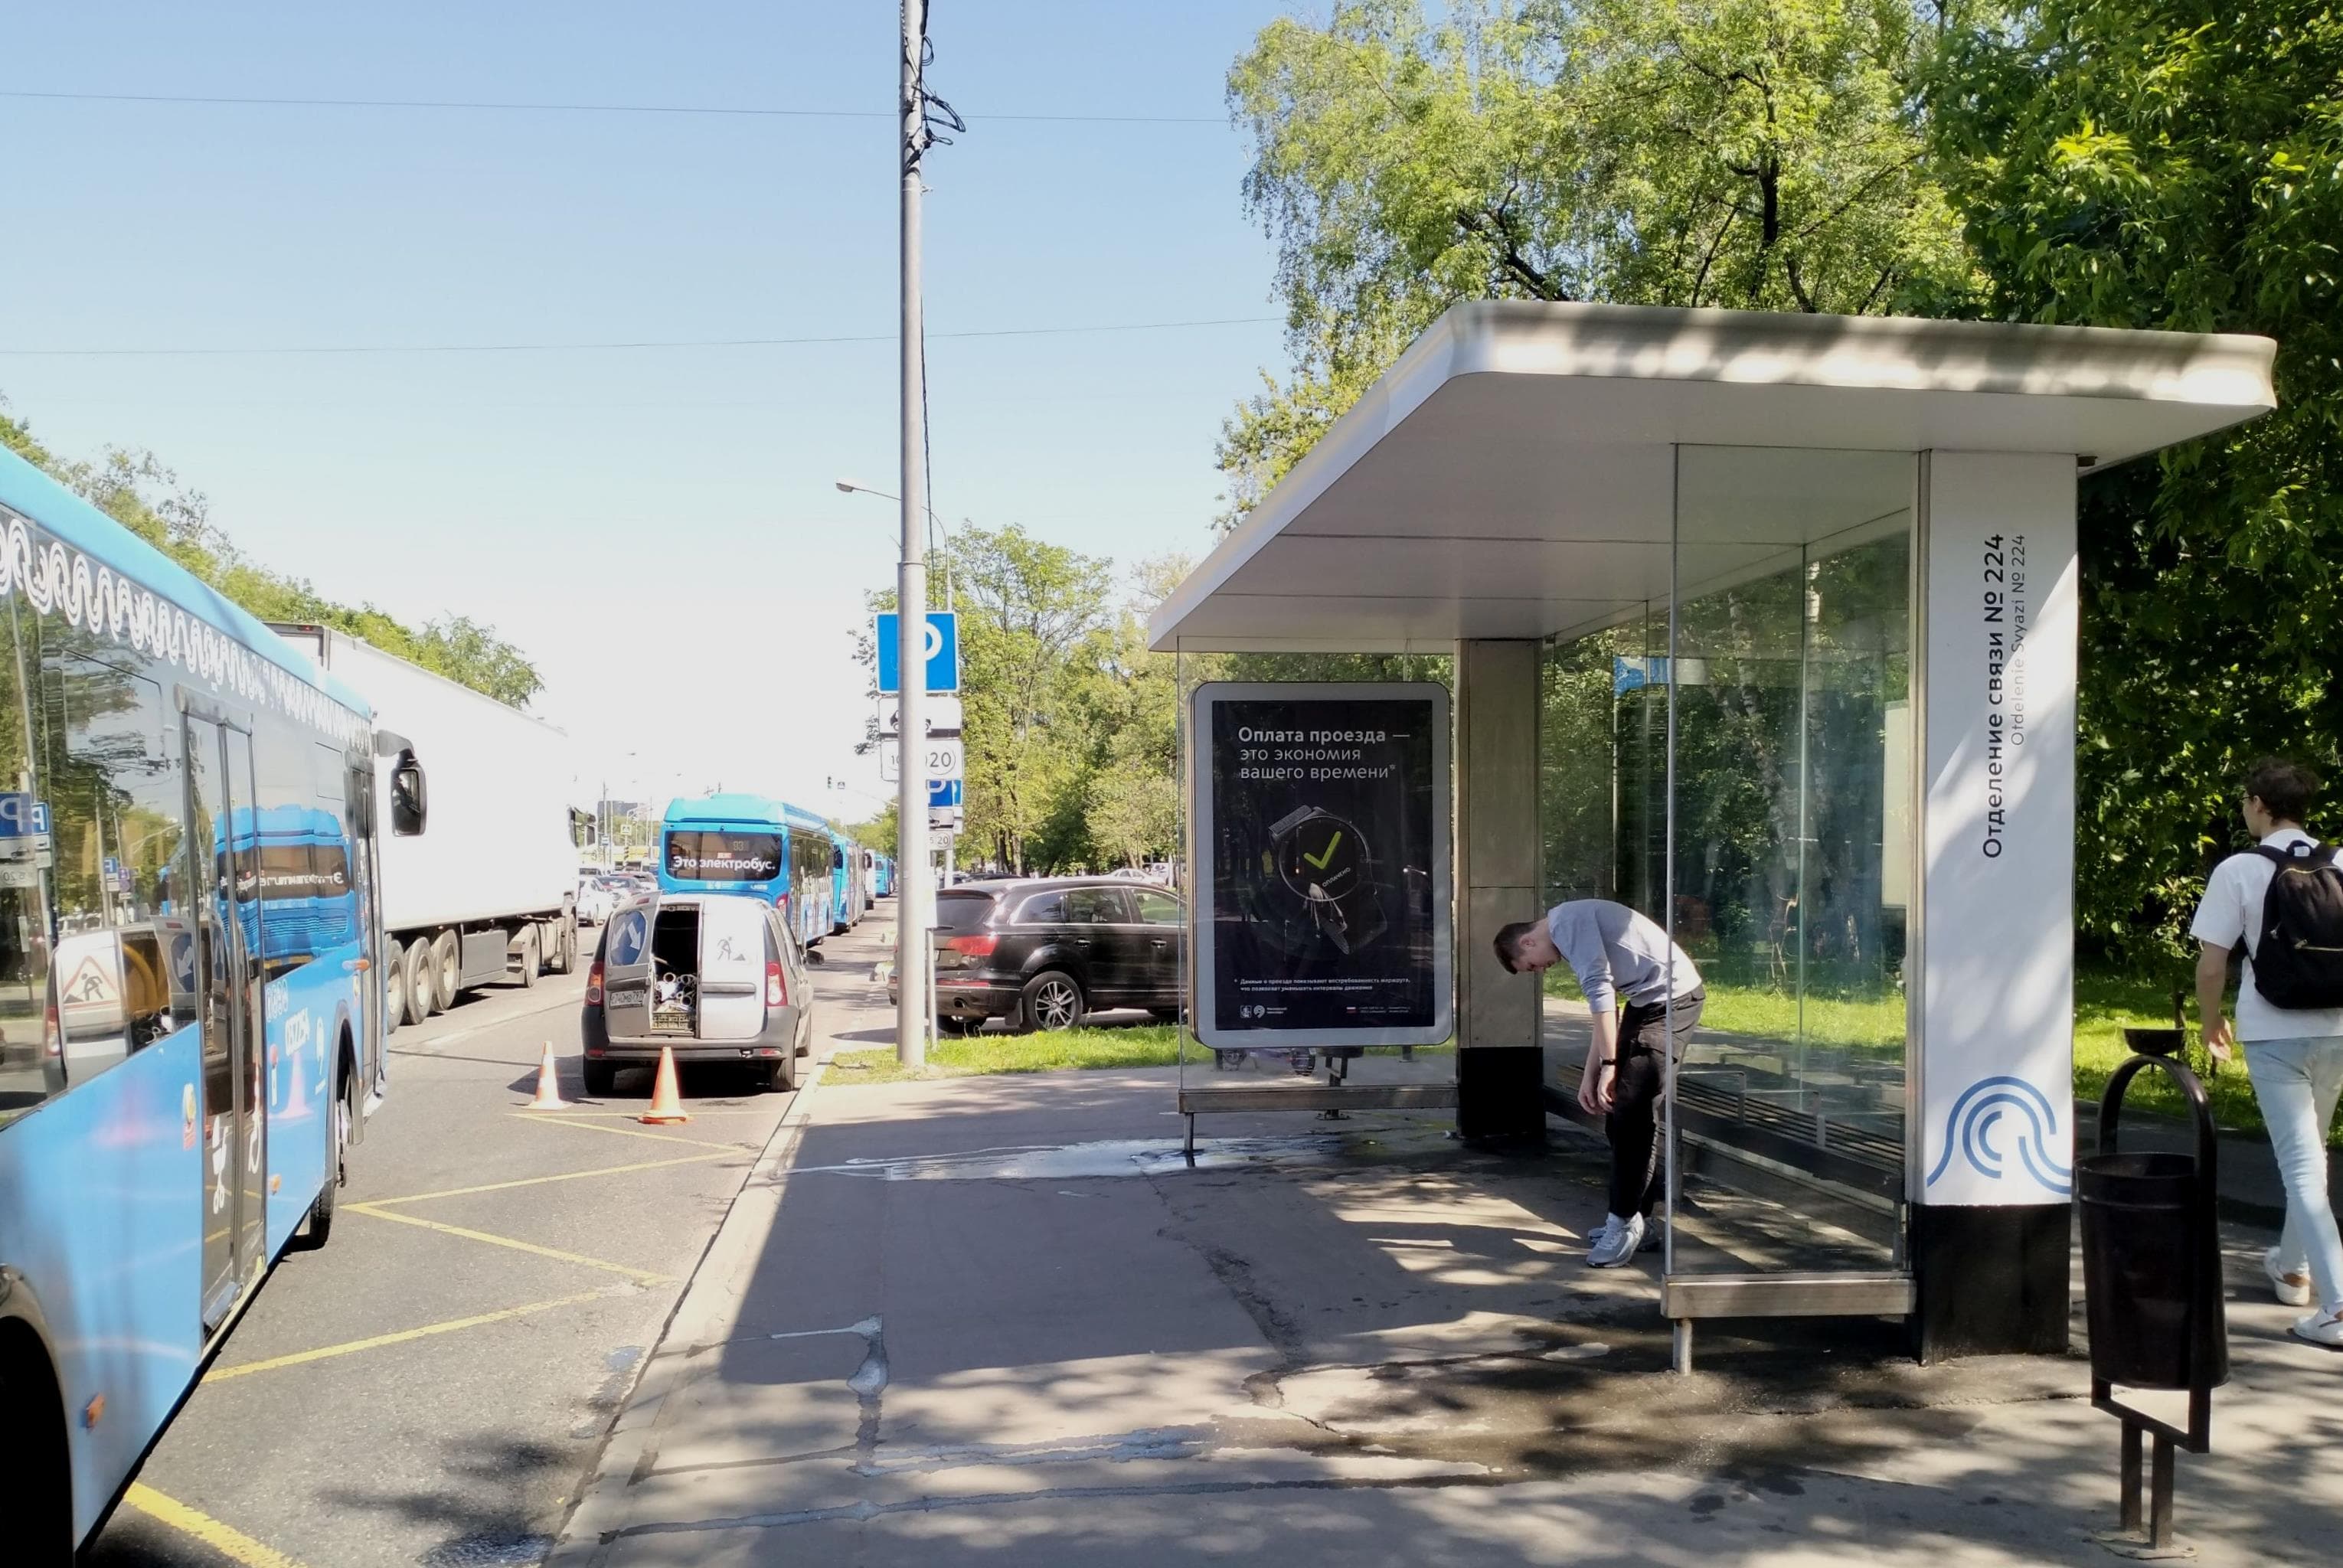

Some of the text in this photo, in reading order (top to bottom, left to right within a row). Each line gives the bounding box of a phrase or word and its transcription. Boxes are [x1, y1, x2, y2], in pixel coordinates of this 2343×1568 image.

[2011, 535, 2025, 567] 224
[2011, 599, 2028, 652] Svyazi
[1983, 534, 2005, 858] Отделение связи № 224
[1238, 727, 1304, 742] Оплата
[1309, 730, 1386, 745] проезда
[930, 752, 951, 767] 20
[1240, 749, 1361, 760] это экономия
[1240, 767, 1304, 779] вашего
[937, 836, 948, 844] 20
[673, 856, 776, 871] Это электробус.
